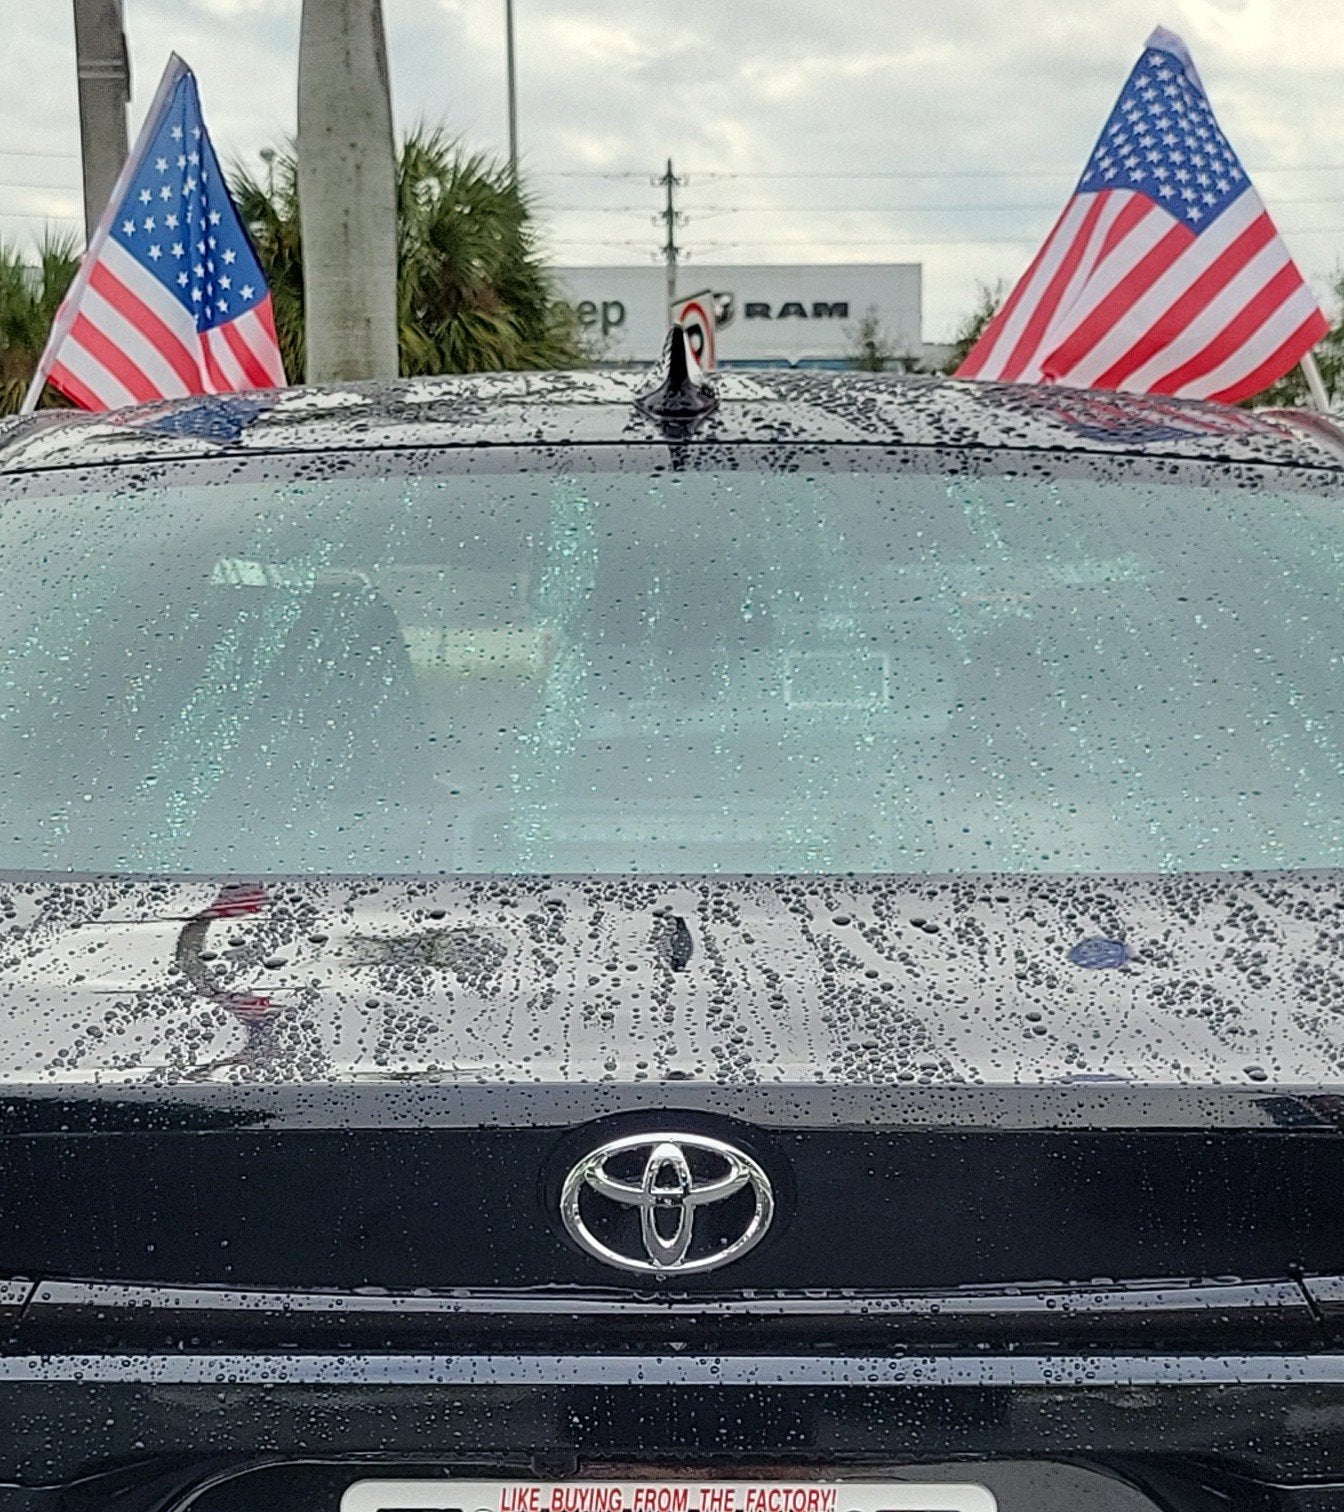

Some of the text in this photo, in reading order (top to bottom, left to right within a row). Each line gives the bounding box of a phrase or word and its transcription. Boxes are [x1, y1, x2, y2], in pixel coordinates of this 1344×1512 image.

[744, 302, 850, 320] RAM
[500, 1487, 838, 1512] LIKE BUYING FROM THE FACTORY!
